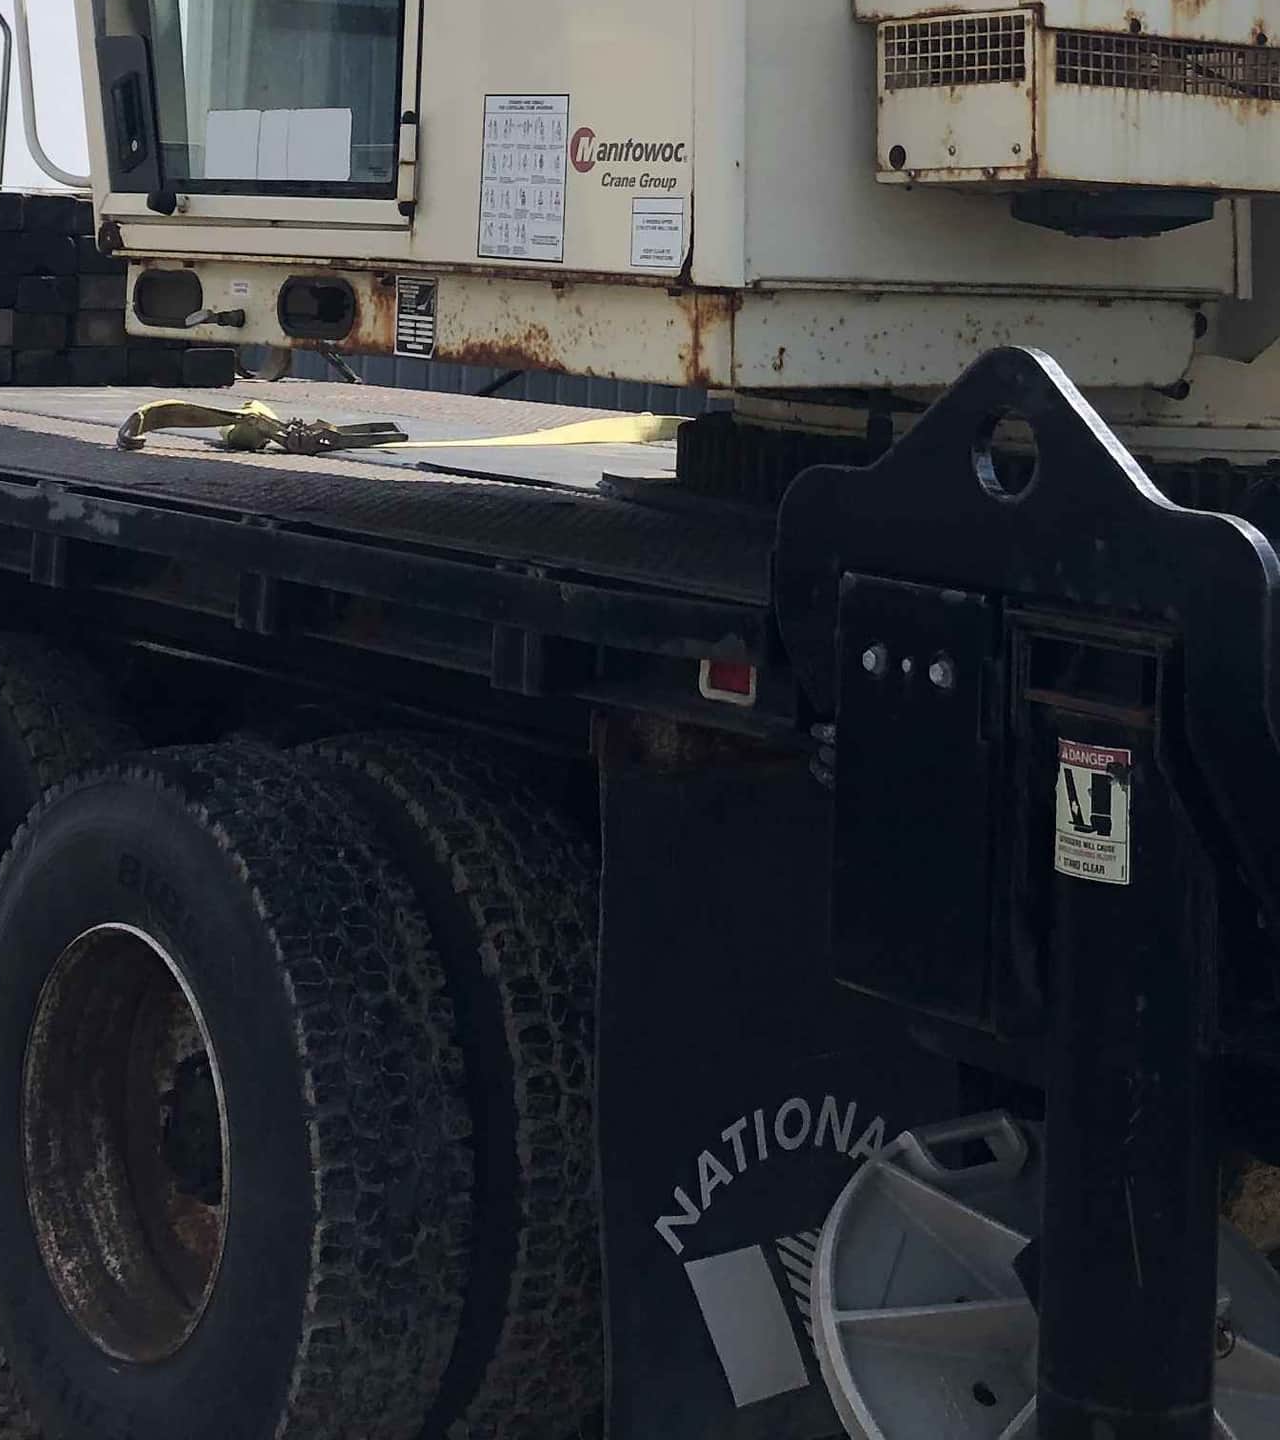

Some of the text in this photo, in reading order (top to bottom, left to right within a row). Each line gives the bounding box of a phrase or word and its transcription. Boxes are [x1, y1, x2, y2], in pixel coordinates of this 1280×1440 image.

[571, 130, 686, 167] Manitowoc
[601, 172, 677, 192] Crane Group
[654, 1095, 886, 1256] NATIONA
